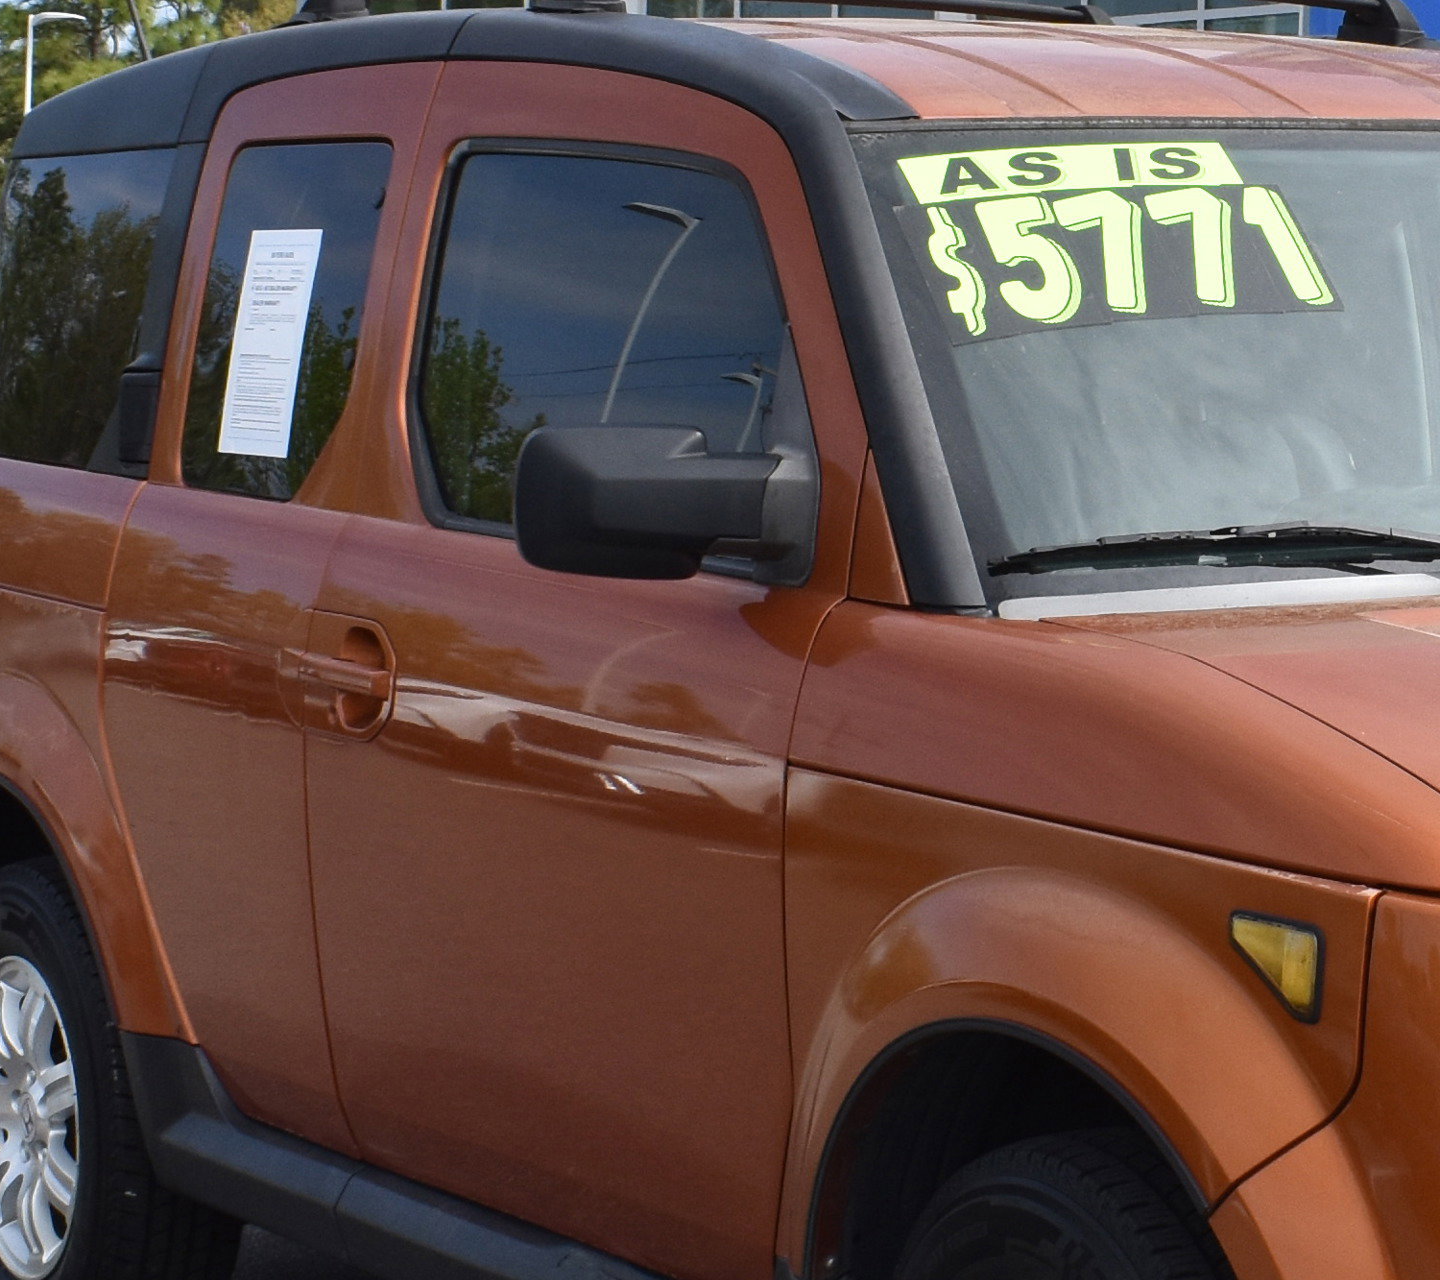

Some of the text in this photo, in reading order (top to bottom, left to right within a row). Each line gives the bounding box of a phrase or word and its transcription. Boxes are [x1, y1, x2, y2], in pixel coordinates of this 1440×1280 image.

[940, 147, 1202, 196] AS IS
[926, 186, 1335, 337] $5771
